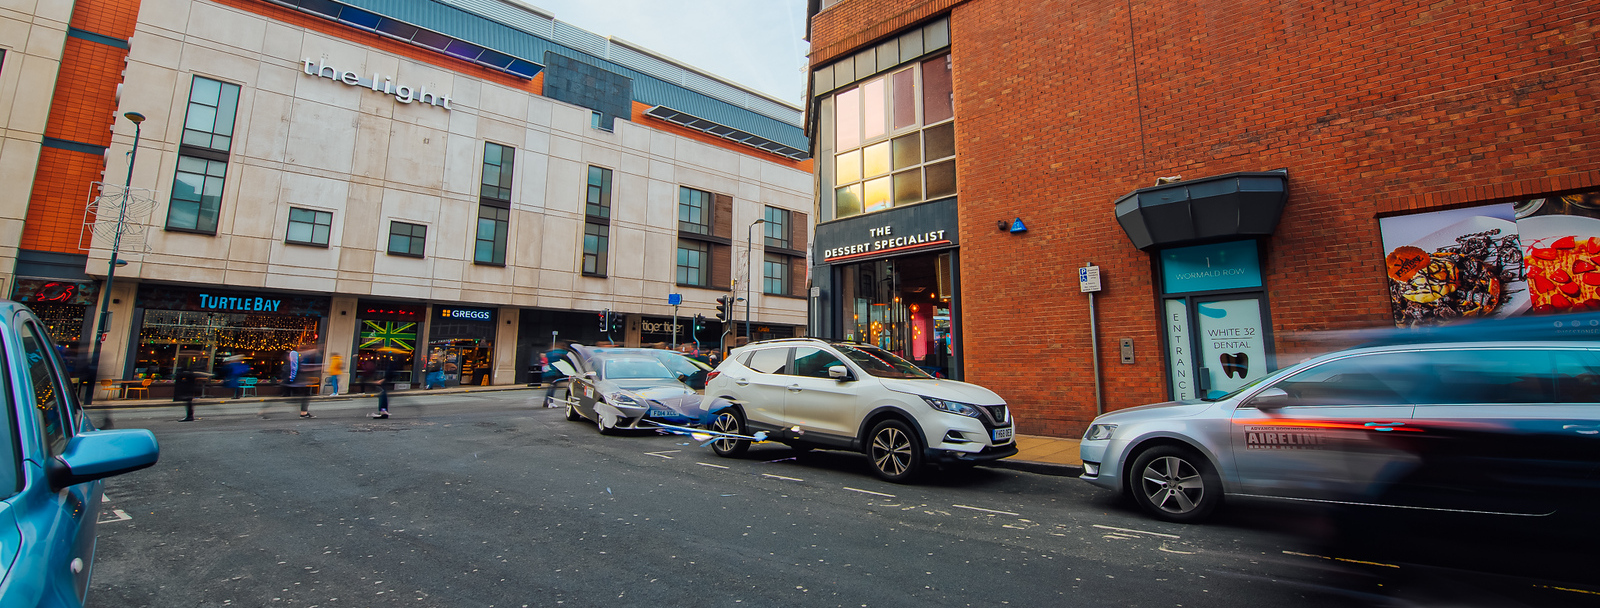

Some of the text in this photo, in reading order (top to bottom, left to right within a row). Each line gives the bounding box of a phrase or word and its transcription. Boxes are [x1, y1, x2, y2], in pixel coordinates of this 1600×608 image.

[301, 57, 453, 111] the light
[869, 226, 892, 238] THE
[824, 230, 945, 258] DESSERT SPECIALIST
[1206, 257, 1211, 268] 1
[1176, 268, 1246, 280] WORMALD ROW
[199, 294, 281, 312] TURTLE BAY
[451, 310, 490, 319] GREGGS
[641, 320, 663, 334] tiger
[1207, 327, 1256, 337] WHITE 32
[1213, 341, 1251, 349] DENTAL
[1173, 313, 1187, 400] ENTRANCE
[1248, 432, 1326, 444] AIRELINE
